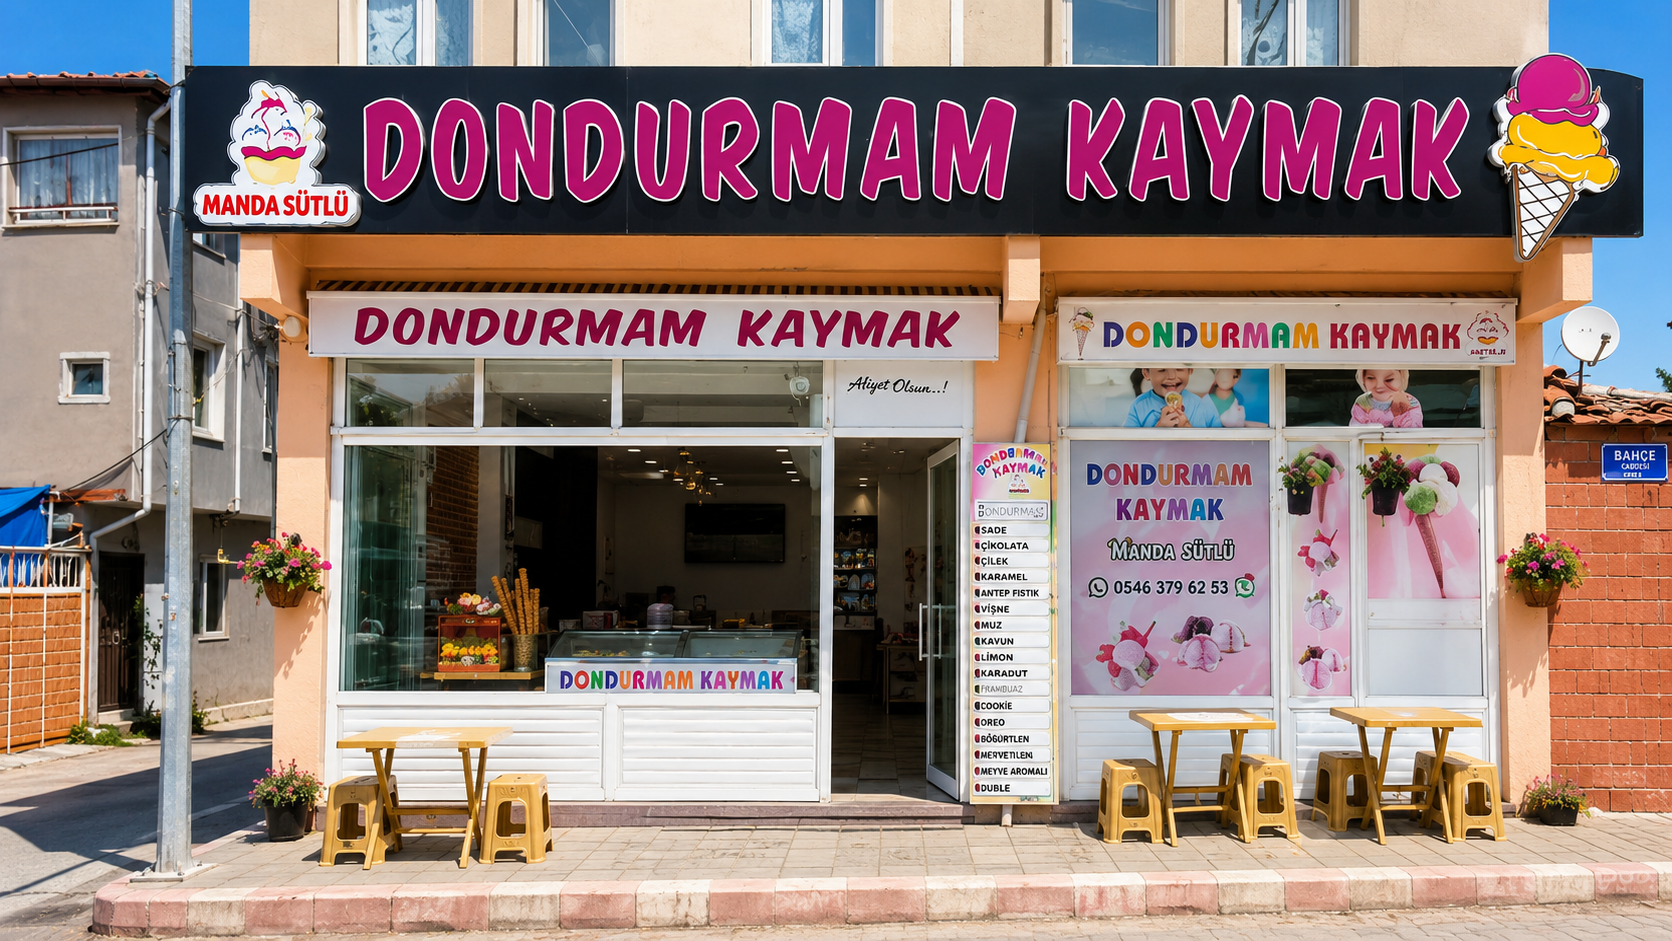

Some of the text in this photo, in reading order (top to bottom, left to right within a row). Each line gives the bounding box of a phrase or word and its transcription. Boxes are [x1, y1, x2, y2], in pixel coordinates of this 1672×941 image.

[363, 94, 1470, 203] DONDURMAM KAYMAK
[203, 189, 348, 216] MANDA SÜTLÜ
[354, 307, 961, 349] DONDURMAM KAYMAK
[1103, 321, 1461, 349] DONDURMAM KAYMAK
[1614, 450, 1656, 462] BAHÇE
[992, 462, 1045, 478] KAYMAK
[1087, 463, 1252, 485] DONDURMAM
[1116, 498, 1224, 521] KAYMAK
[981, 526, 1007, 534] SADE
[981, 540, 1029, 552] ÇİKOLATA
[1181, 538, 1235, 561] SÜTLÜ
[981, 556, 1008, 567] ÇİLEK
[981, 573, 1027, 581] KARAMEL
[981, 588, 1039, 597] ANTEP FISTIK
[1114, 580, 1228, 594] 0546 379 62 53
[981, 604, 1009, 615] VİŞNE
[981, 621, 1002, 629] MUZ
[981, 652, 1013, 661] LİMON
[981, 669, 1028, 677] KARADUT
[560, 670, 784, 690] DONDURMAM KAYMAK
[981, 701, 1012, 710] COOKİE
[980, 767, 1048, 775] MEYVE AROMALI
[981, 784, 1010, 792] DUBLE
